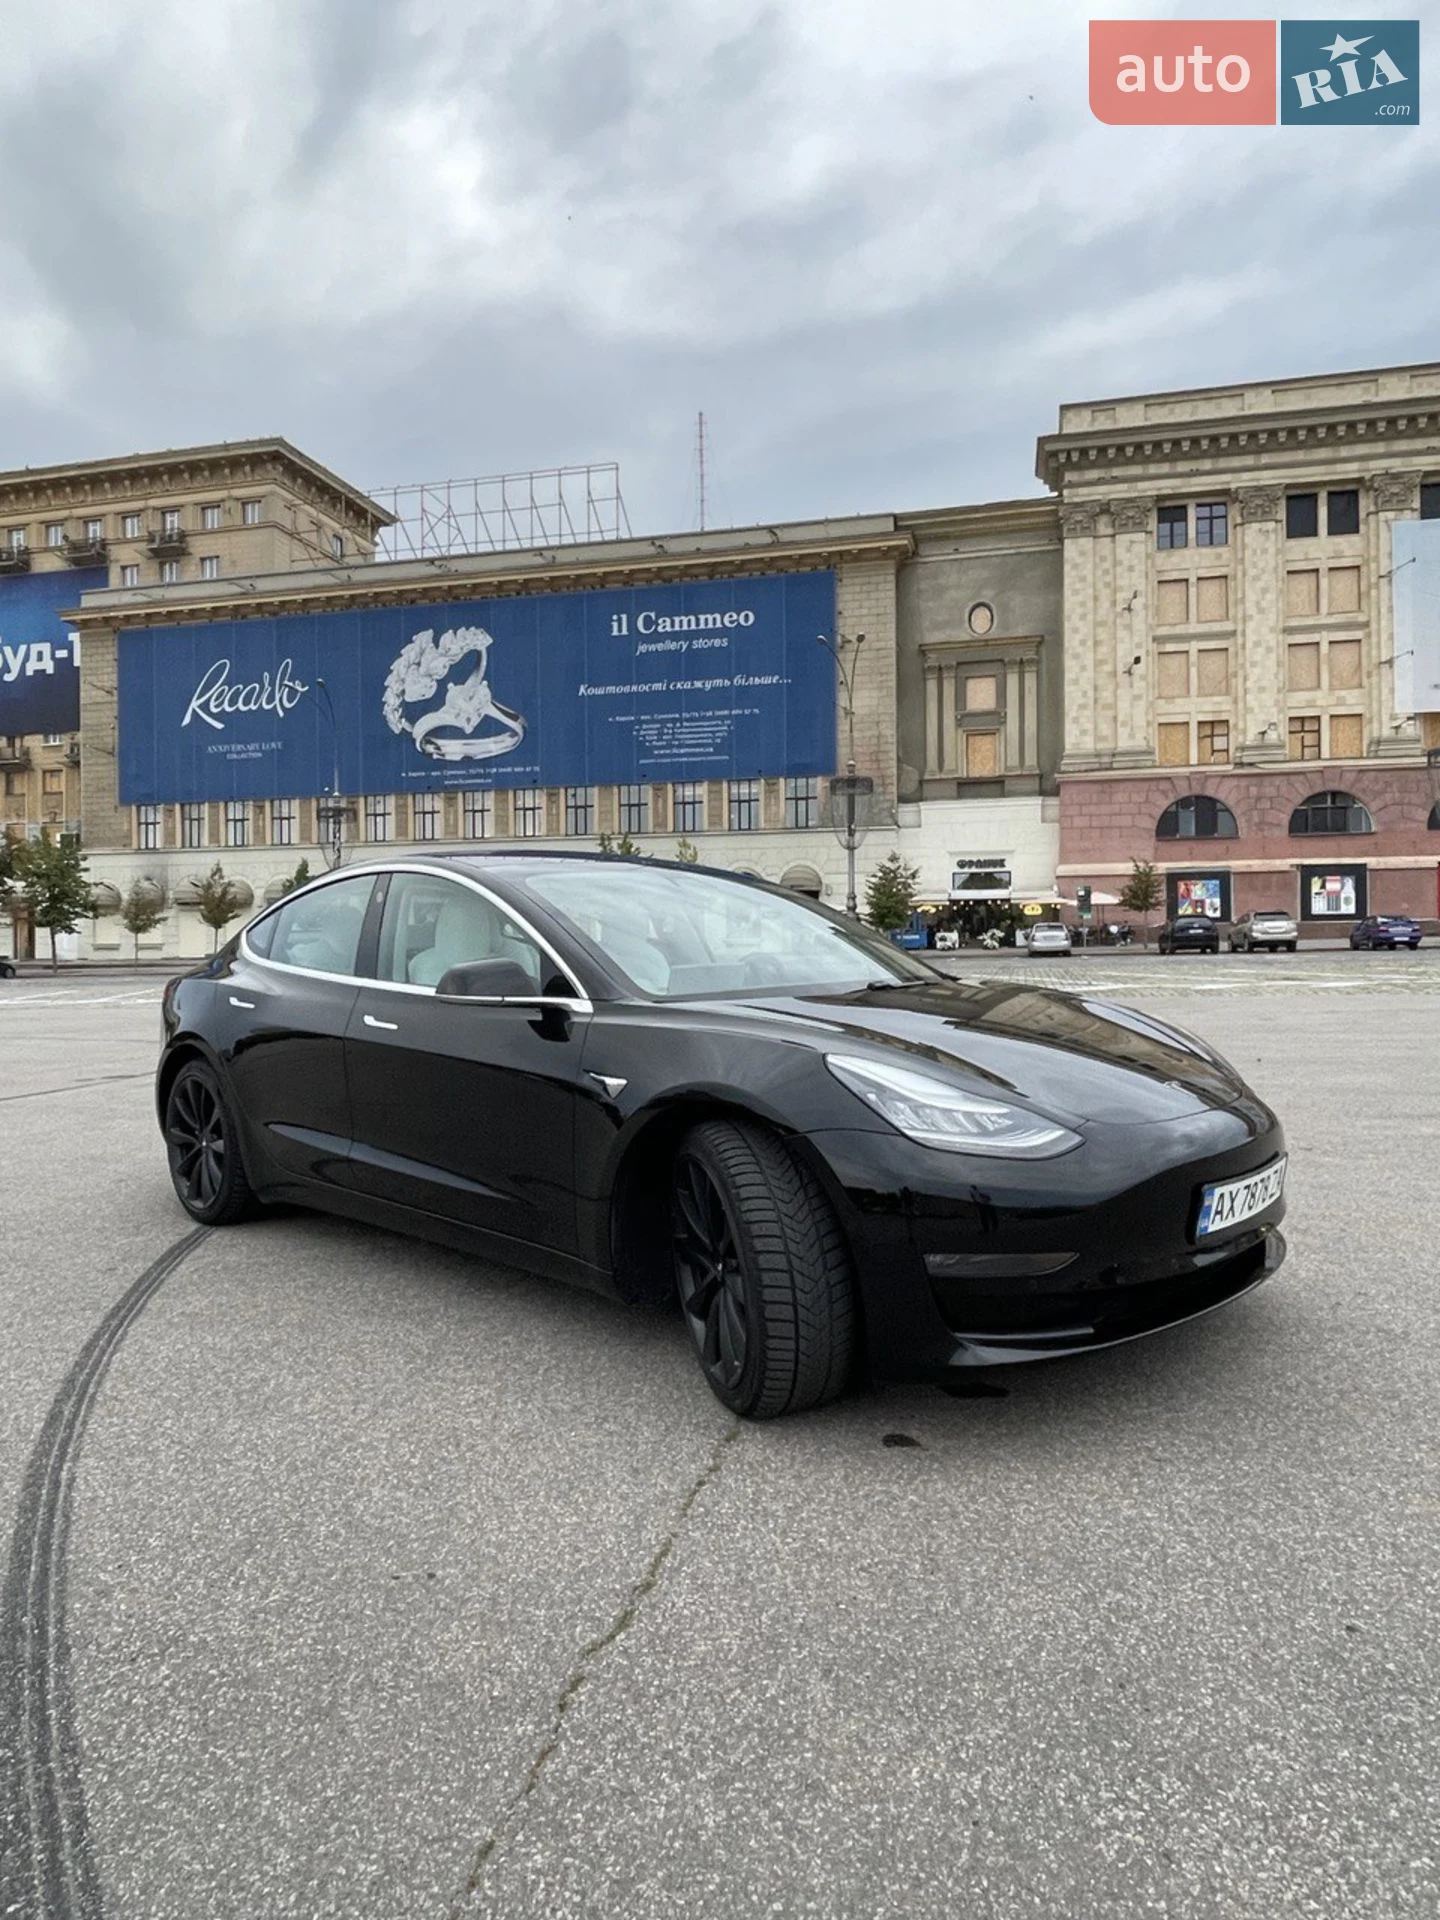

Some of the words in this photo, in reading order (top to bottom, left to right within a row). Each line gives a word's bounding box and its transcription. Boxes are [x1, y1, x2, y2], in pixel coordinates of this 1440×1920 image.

[611, 613, 629, 636] il
[636, 609, 756, 635] Cammeo
[0, 631, 81, 682] уд-1
[636, 638, 689, 656] jewellery
[692, 636, 729, 650] stores
[181, 658, 310, 730] Recarlo
[578, 679, 667, 697] Коштовності
[669, 678, 731, 692] скажуть
[733, 673, 792, 686] більше...
